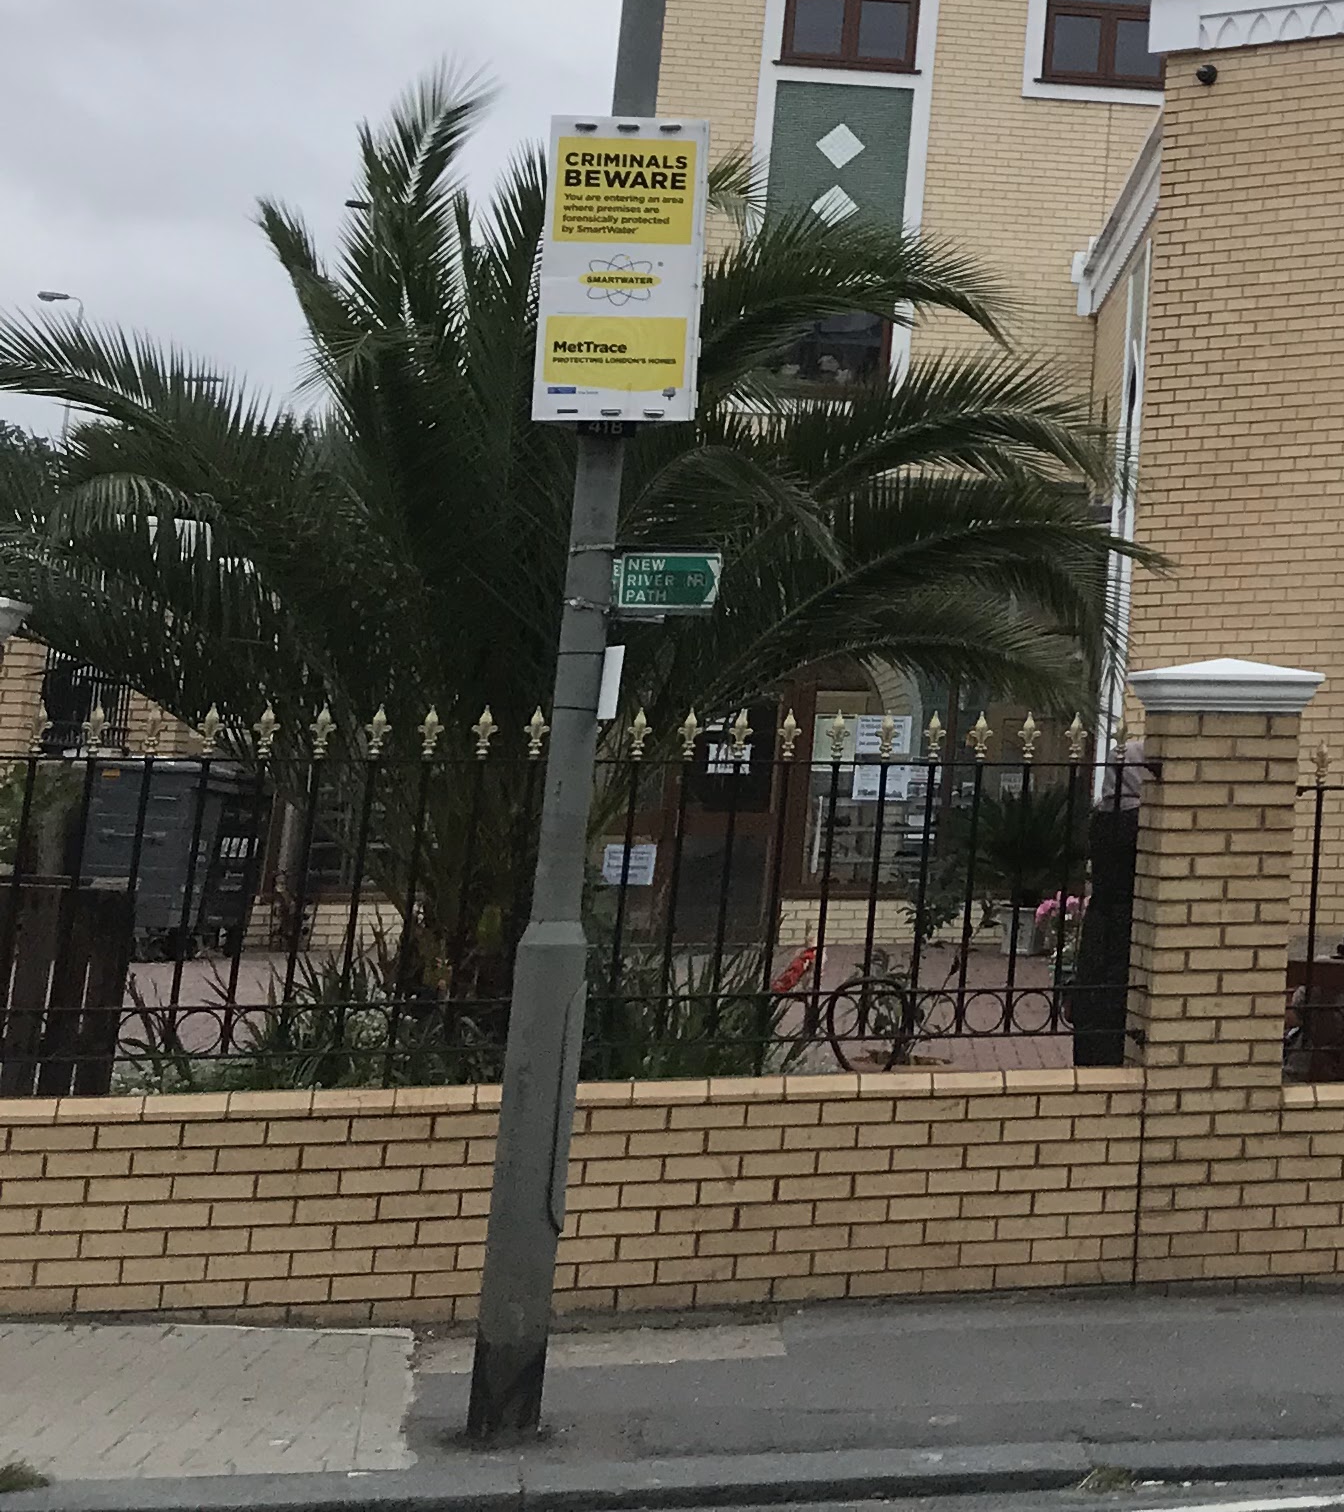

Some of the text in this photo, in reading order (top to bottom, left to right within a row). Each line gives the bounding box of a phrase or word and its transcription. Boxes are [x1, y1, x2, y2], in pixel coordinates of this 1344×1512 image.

[565, 152, 687, 169] CRIMINALS
[564, 169, 687, 190] BEWARE
[604, 194, 645, 204] entering
[563, 203, 594, 211] where
[597, 204, 641, 213] premises
[562, 214, 670, 224] forensically protected
[561, 225, 574, 234] by
[586, 275, 653, 284] SMARTWATER
[552, 341, 628, 354] MetTrace
[552, 356, 604, 364] PROTECTING
[605, 357, 647, 365] LONDON'S
[628, 558, 666, 571] NEW
[627, 574, 675, 586] RIVER
[625, 589, 667, 602] PATH
